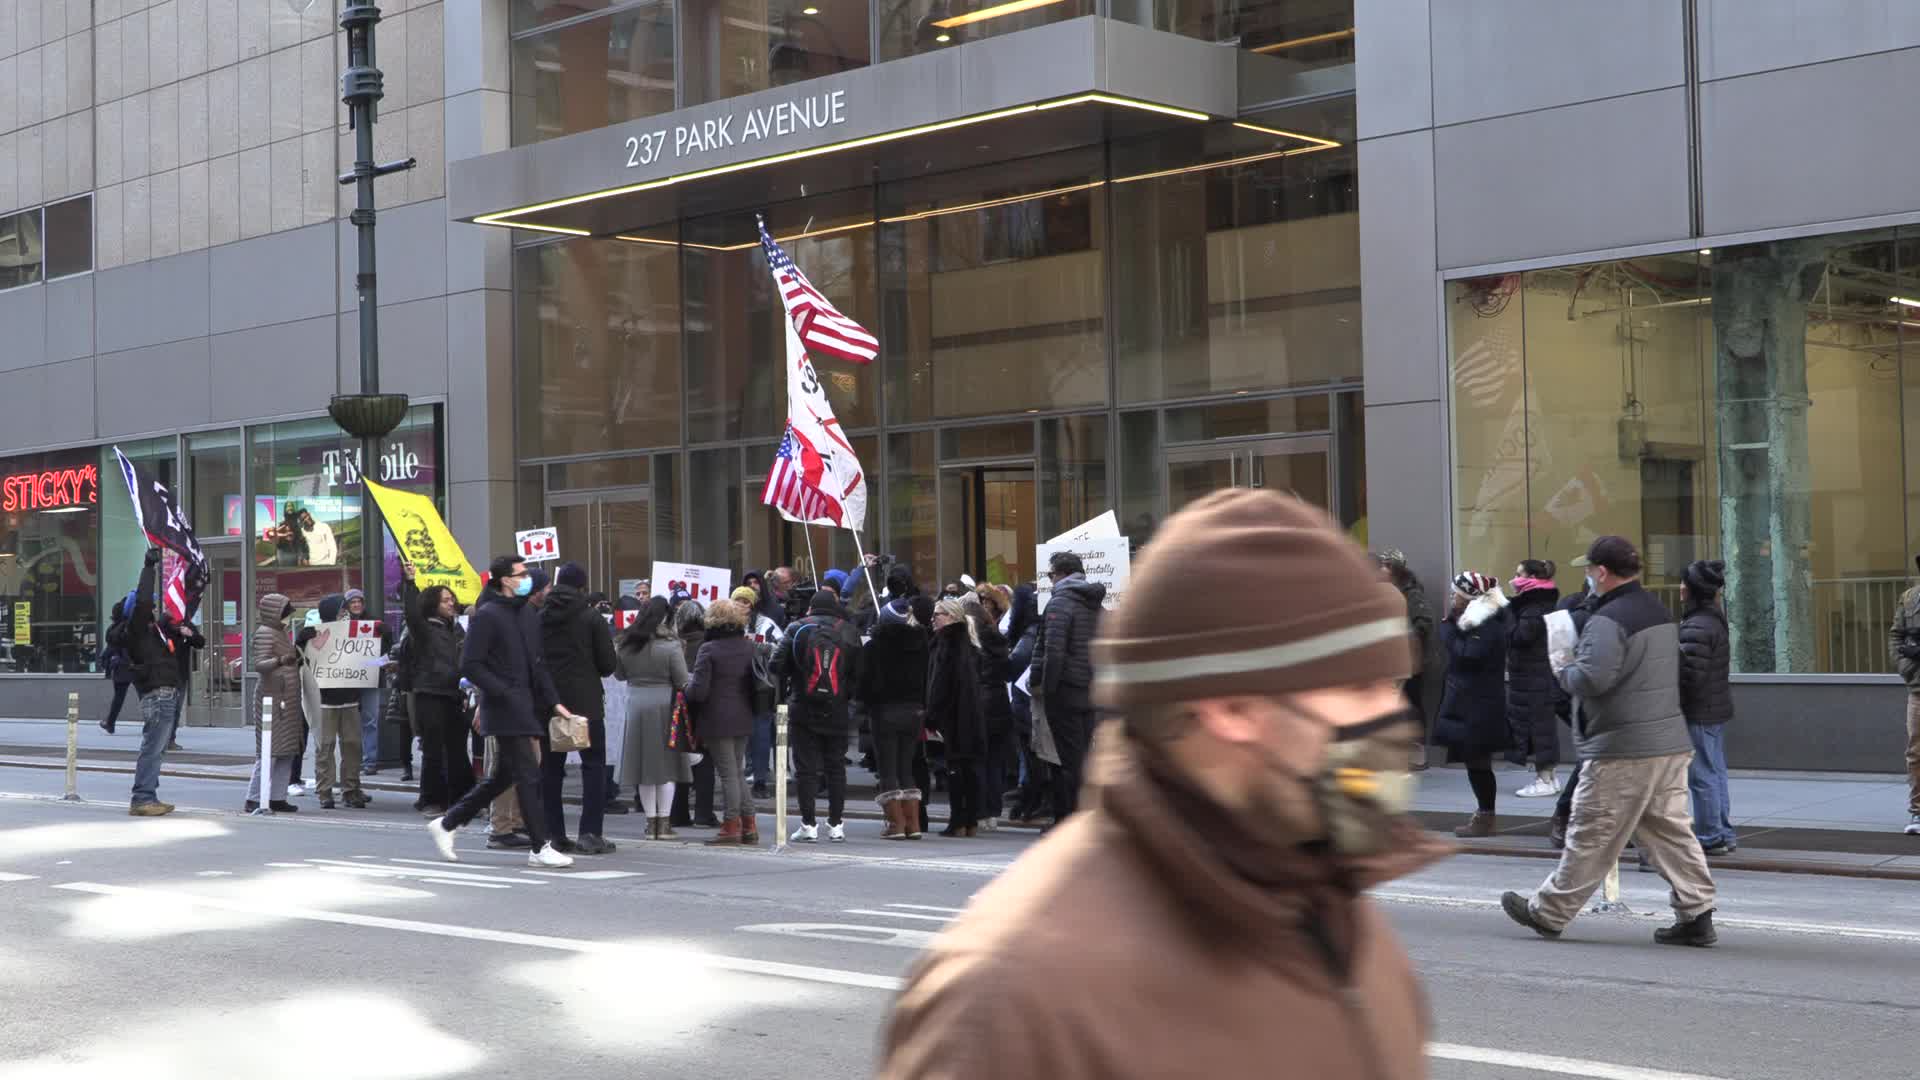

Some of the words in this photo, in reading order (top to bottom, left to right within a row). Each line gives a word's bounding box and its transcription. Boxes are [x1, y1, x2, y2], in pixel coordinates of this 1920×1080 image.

[626, 131, 666, 168] 237
[675, 115, 734, 157] PARK
[742, 90, 845, 144] AVENUE
[438, 579, 450, 588] ON
[455, 580, 467, 590] ME
[328, 639, 375, 664] YOUR
